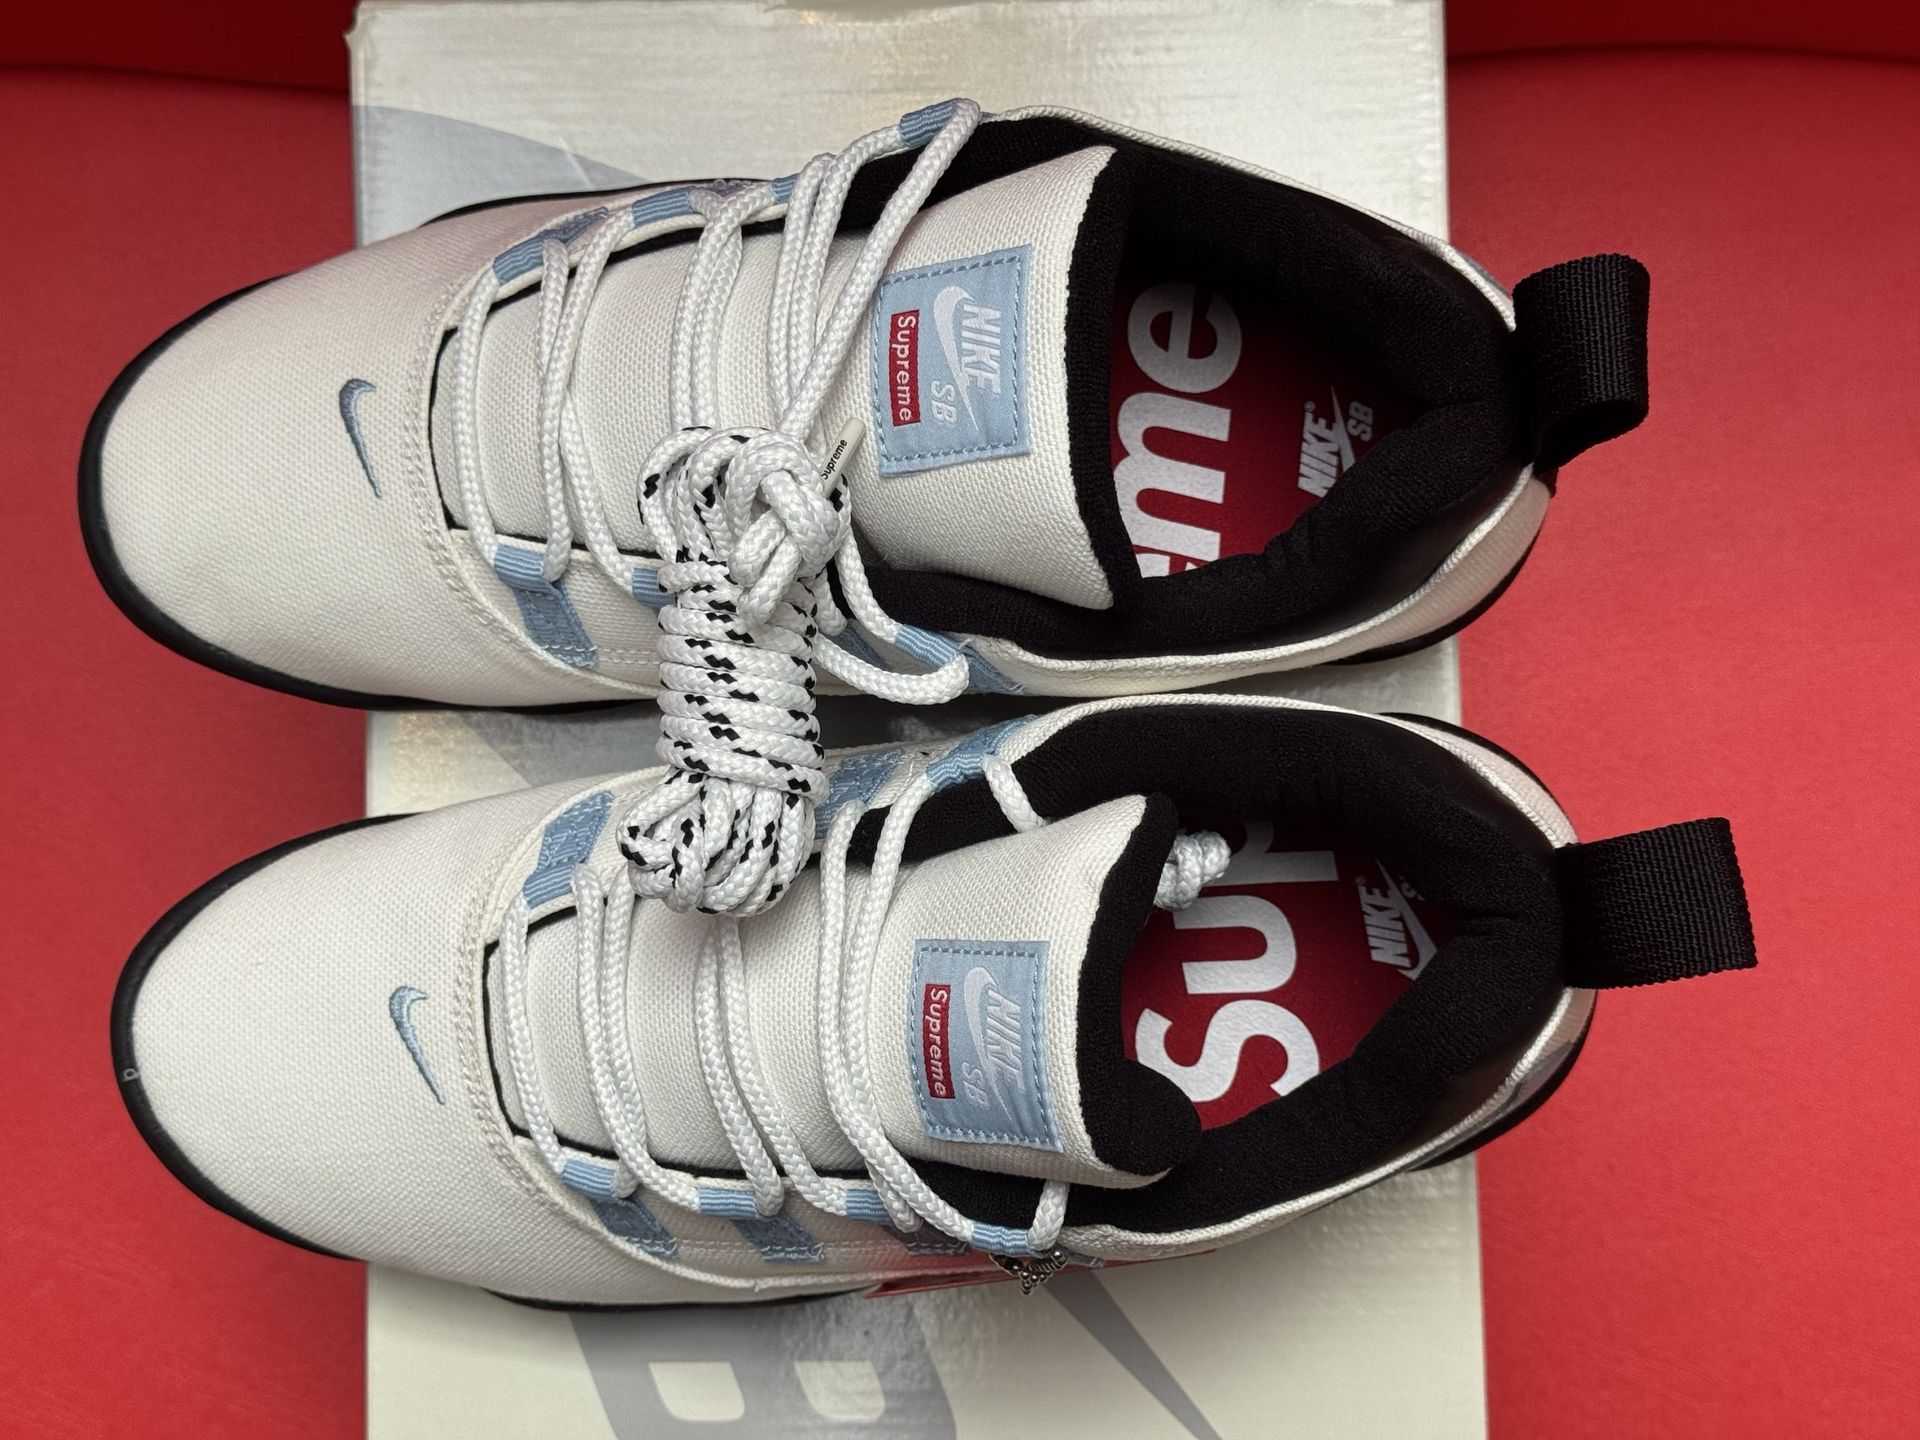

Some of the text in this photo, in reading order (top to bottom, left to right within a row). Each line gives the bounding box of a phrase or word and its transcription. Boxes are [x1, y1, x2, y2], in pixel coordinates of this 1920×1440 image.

[891, 314, 917, 422] Supreme
[961, 304, 1001, 395] NIKE
[931, 380, 956, 425] SB
[1346, 401, 1373, 442] SB
[820, 439, 848, 480] Supreme
[1298, 413, 1342, 498] NIKE
[1357, 886, 1412, 967] NIKE
[924, 987, 948, 1097] Supreme
[986, 989, 1026, 1092] NIKE
[961, 1061, 990, 1112] SB
